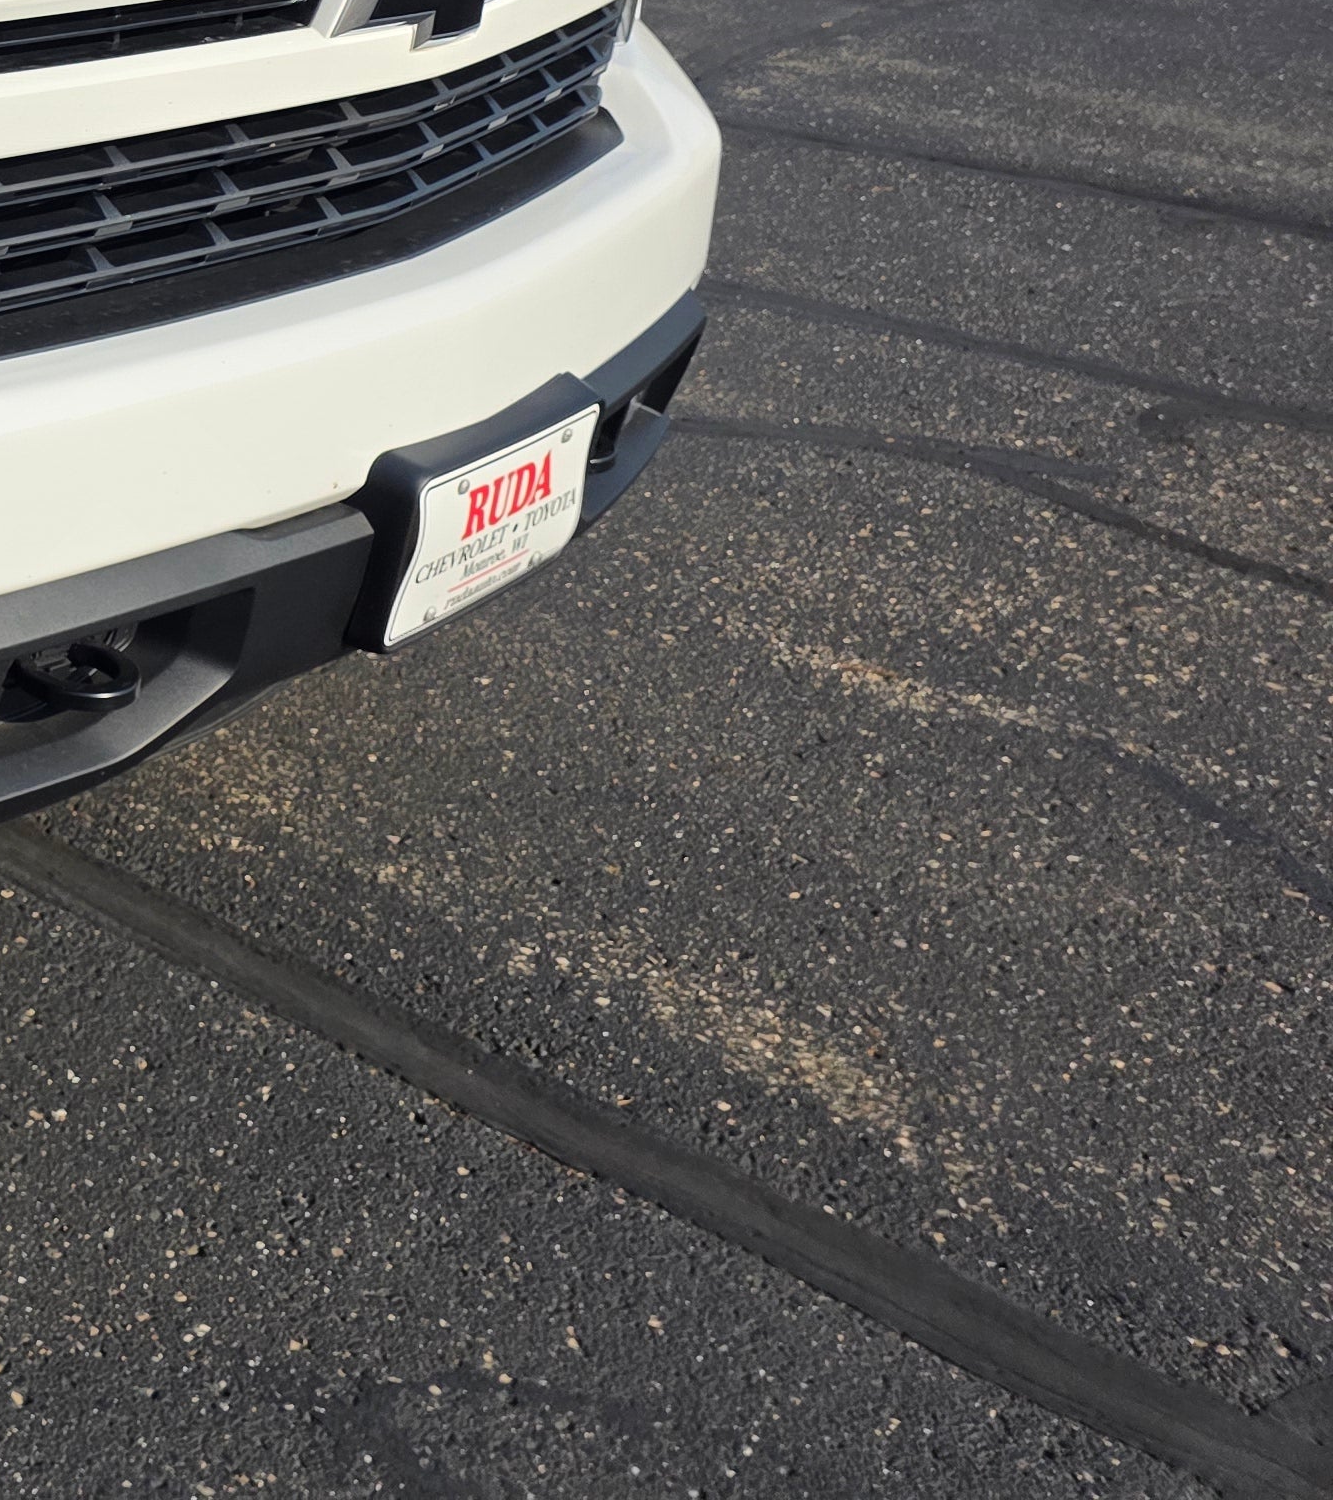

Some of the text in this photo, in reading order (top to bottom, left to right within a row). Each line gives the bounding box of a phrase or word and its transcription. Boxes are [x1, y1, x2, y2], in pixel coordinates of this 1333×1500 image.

[415, 487, 577, 584] CHEVROLET TOYOTA
[461, 450, 552, 542] RUDA
